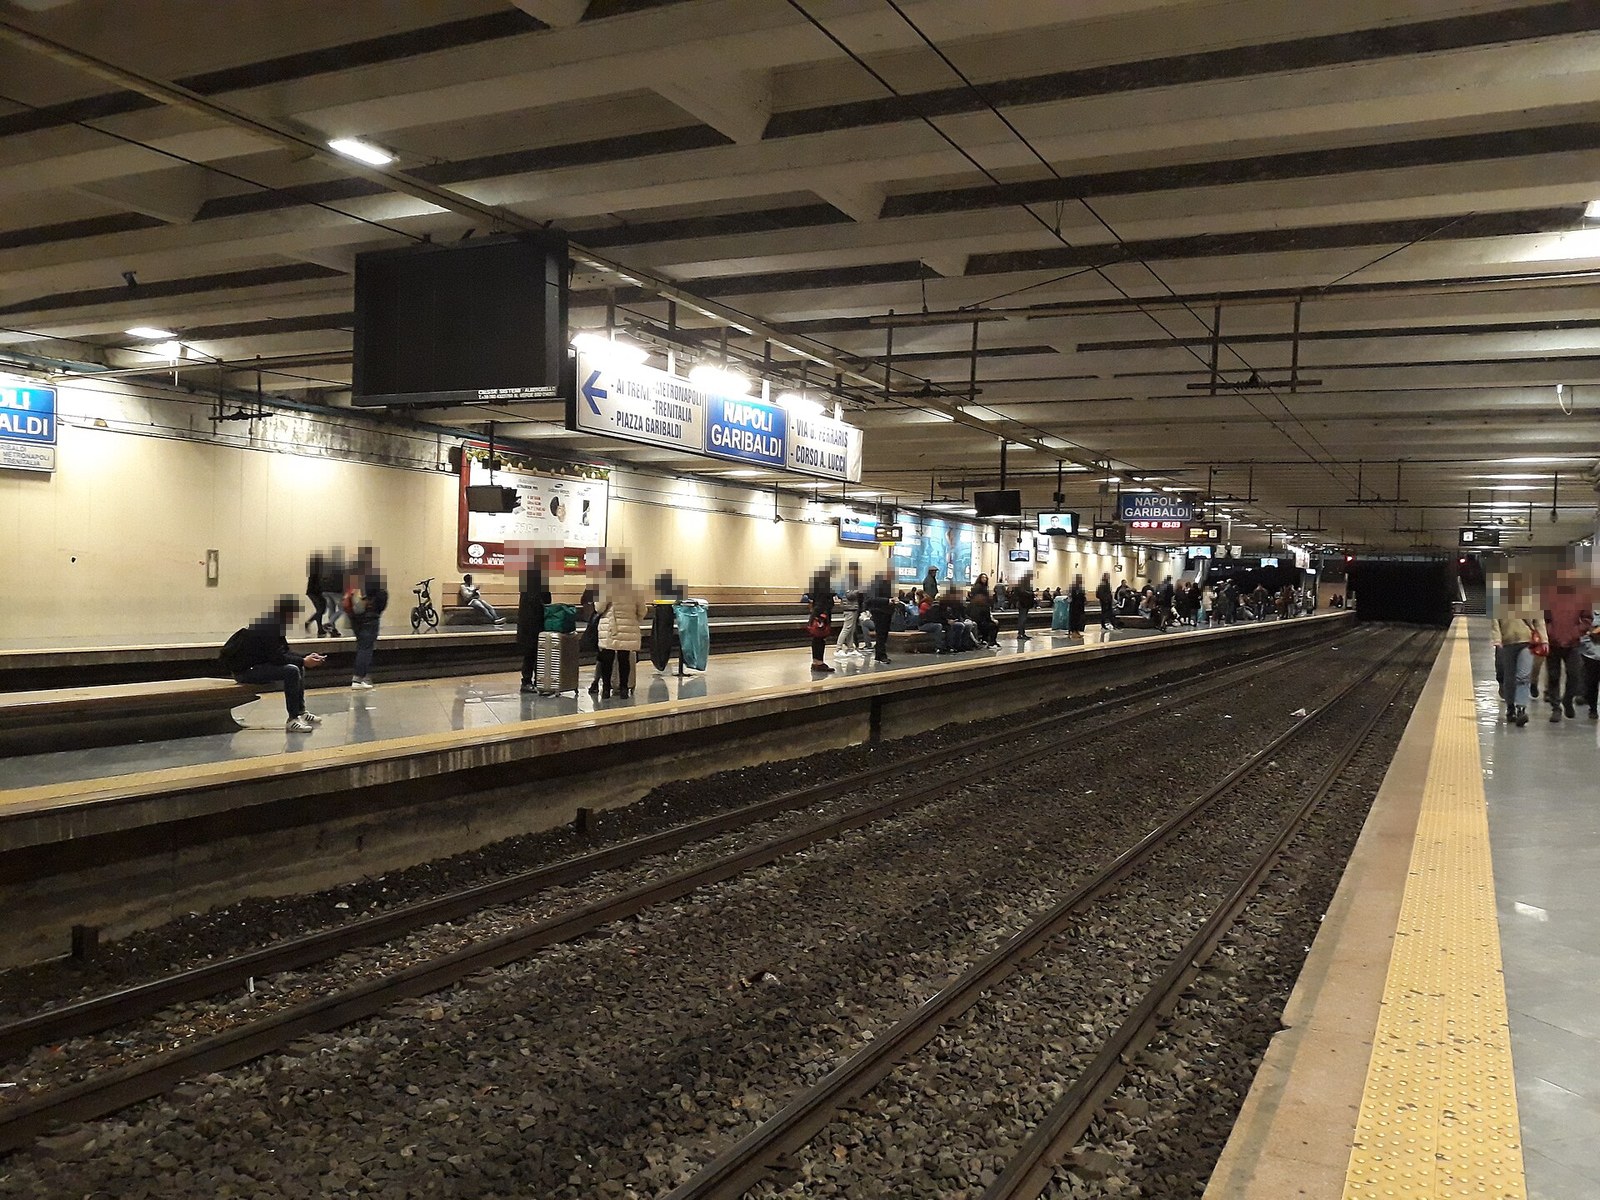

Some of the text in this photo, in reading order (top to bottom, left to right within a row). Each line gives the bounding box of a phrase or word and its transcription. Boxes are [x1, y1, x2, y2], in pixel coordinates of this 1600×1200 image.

[616, 378, 625, 395] AI
[616, 410, 682, 439] PIAZZA GARIBALDI
[723, 400, 773, 432] NAPOLI
[796, 418, 808, 438] VIA
[711, 424, 782, 458] GARIBALDI
[2, 451, 50, 461] METRONAPOLI
[795, 444, 819, 466] CORSO
[828, 453, 846, 472] LUCCI
[1124, 507, 1189, 517] GARIBALDI
[1135, 497, 1179, 507] NAPOL
